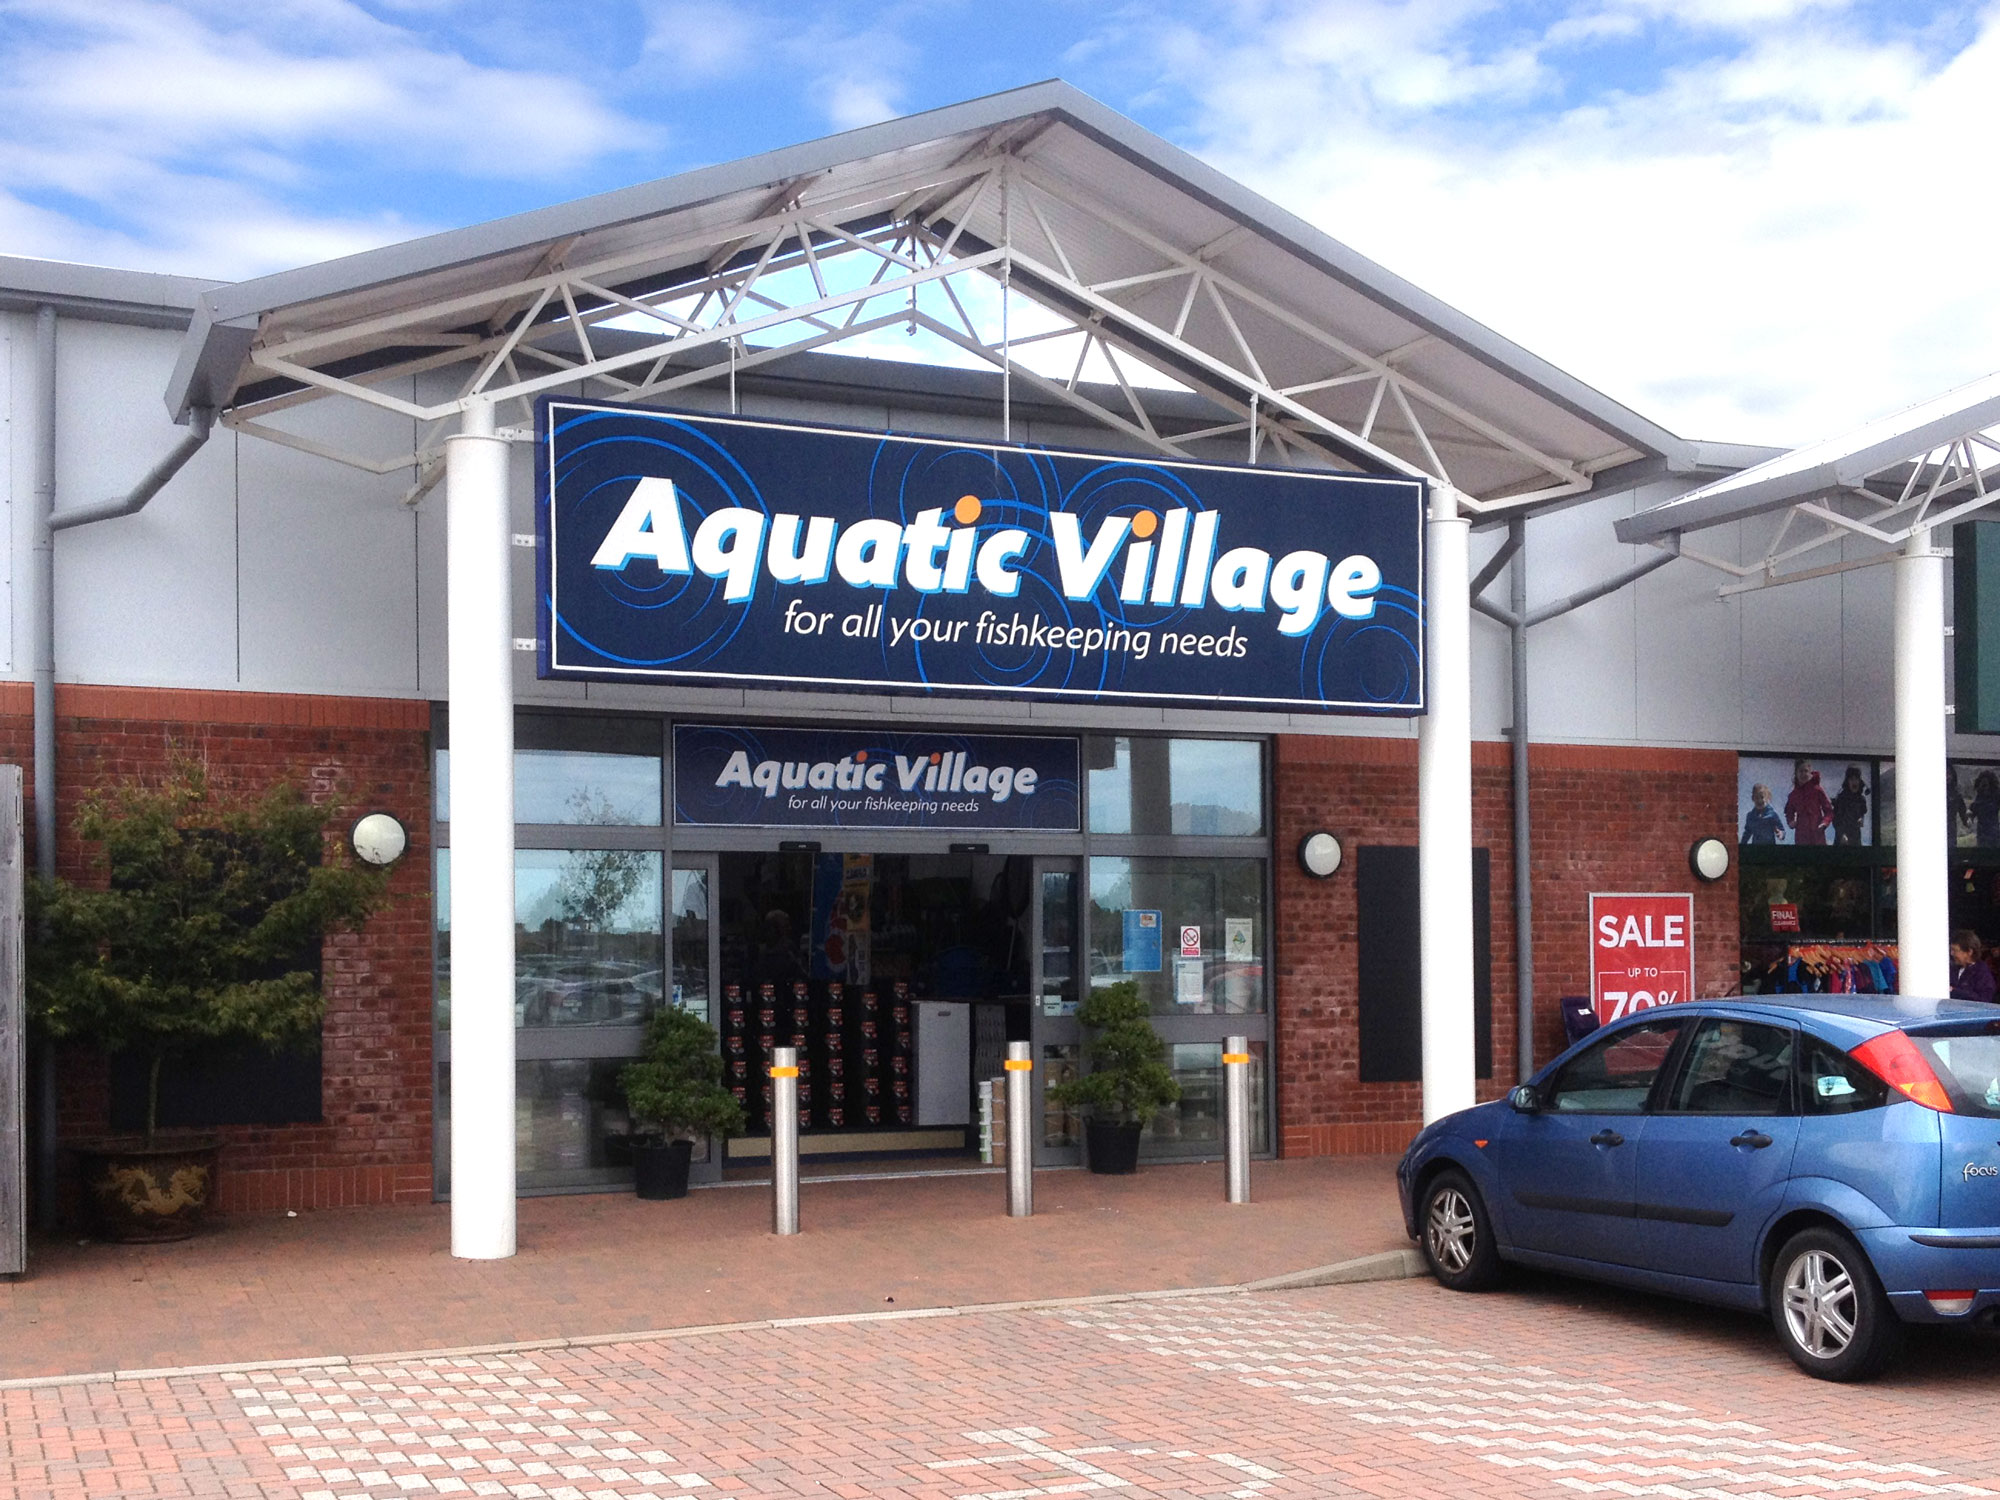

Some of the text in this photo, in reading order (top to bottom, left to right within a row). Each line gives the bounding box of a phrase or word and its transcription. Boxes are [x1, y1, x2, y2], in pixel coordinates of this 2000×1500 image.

[591, 476, 1384, 638] Aquatic Village
[784, 599, 1250, 660] for all your fishkeeping needs
[715, 749, 1039, 803] Aquatic Village
[787, 794, 980, 815] for all your fishkeeping needs
[1598, 914, 1685, 949] SALE
[1771, 910, 1796, 920] FINAL
[1627, 967, 1658, 978] UP TO
